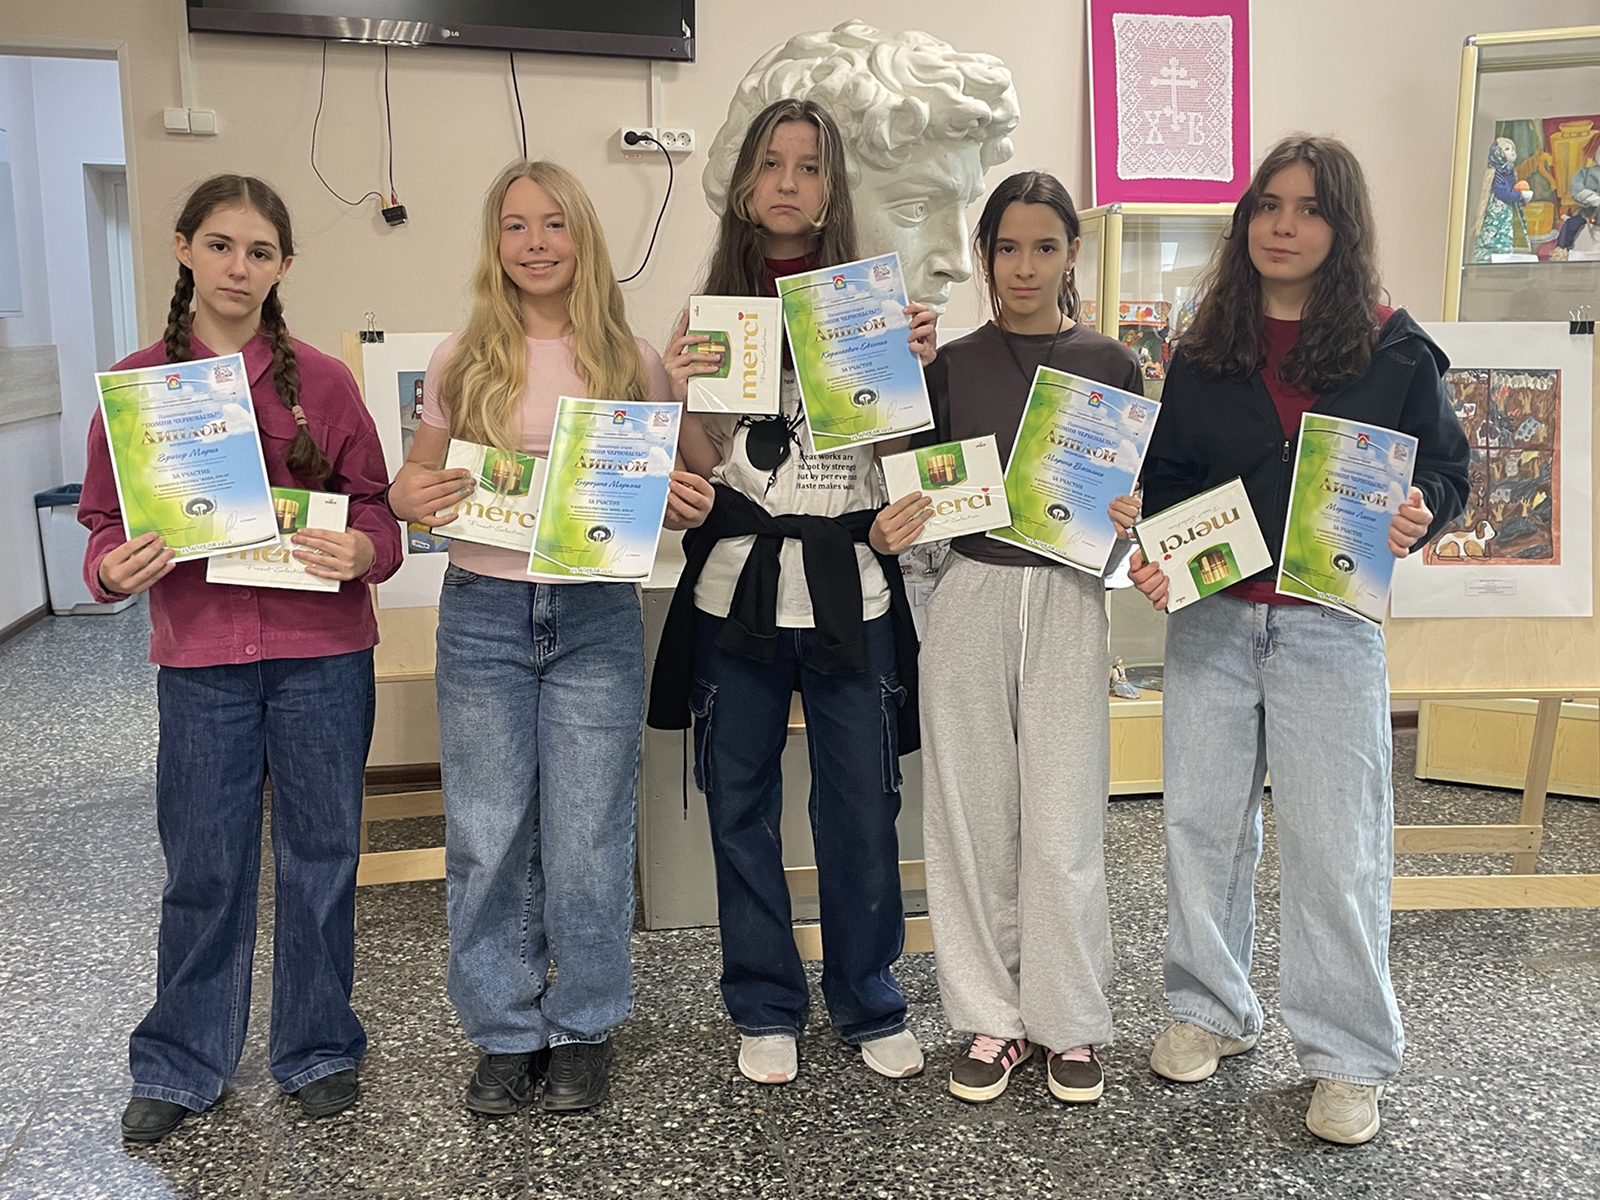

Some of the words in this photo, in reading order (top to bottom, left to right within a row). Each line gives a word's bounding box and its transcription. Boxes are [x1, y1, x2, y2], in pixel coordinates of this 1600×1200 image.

[812, 313, 887, 343] ДИПЛОМ
[738, 311, 759, 399] merci
[138, 417, 229, 446] ДИПЛОМ
[1042, 427, 1119, 464] ДИПЛОМ
[573, 454, 649, 472] ДИПЛОМ
[819, 452, 841, 460] works
[821, 462, 830, 471] by
[180, 467, 211, 478] УЧАСТИЕ
[1058, 477, 1084, 490] УЧАСТИЕ
[1320, 475, 1391, 507] ДИПЛОМ
[452, 500, 536, 529] merc
[1159, 506, 1241, 561] merci
